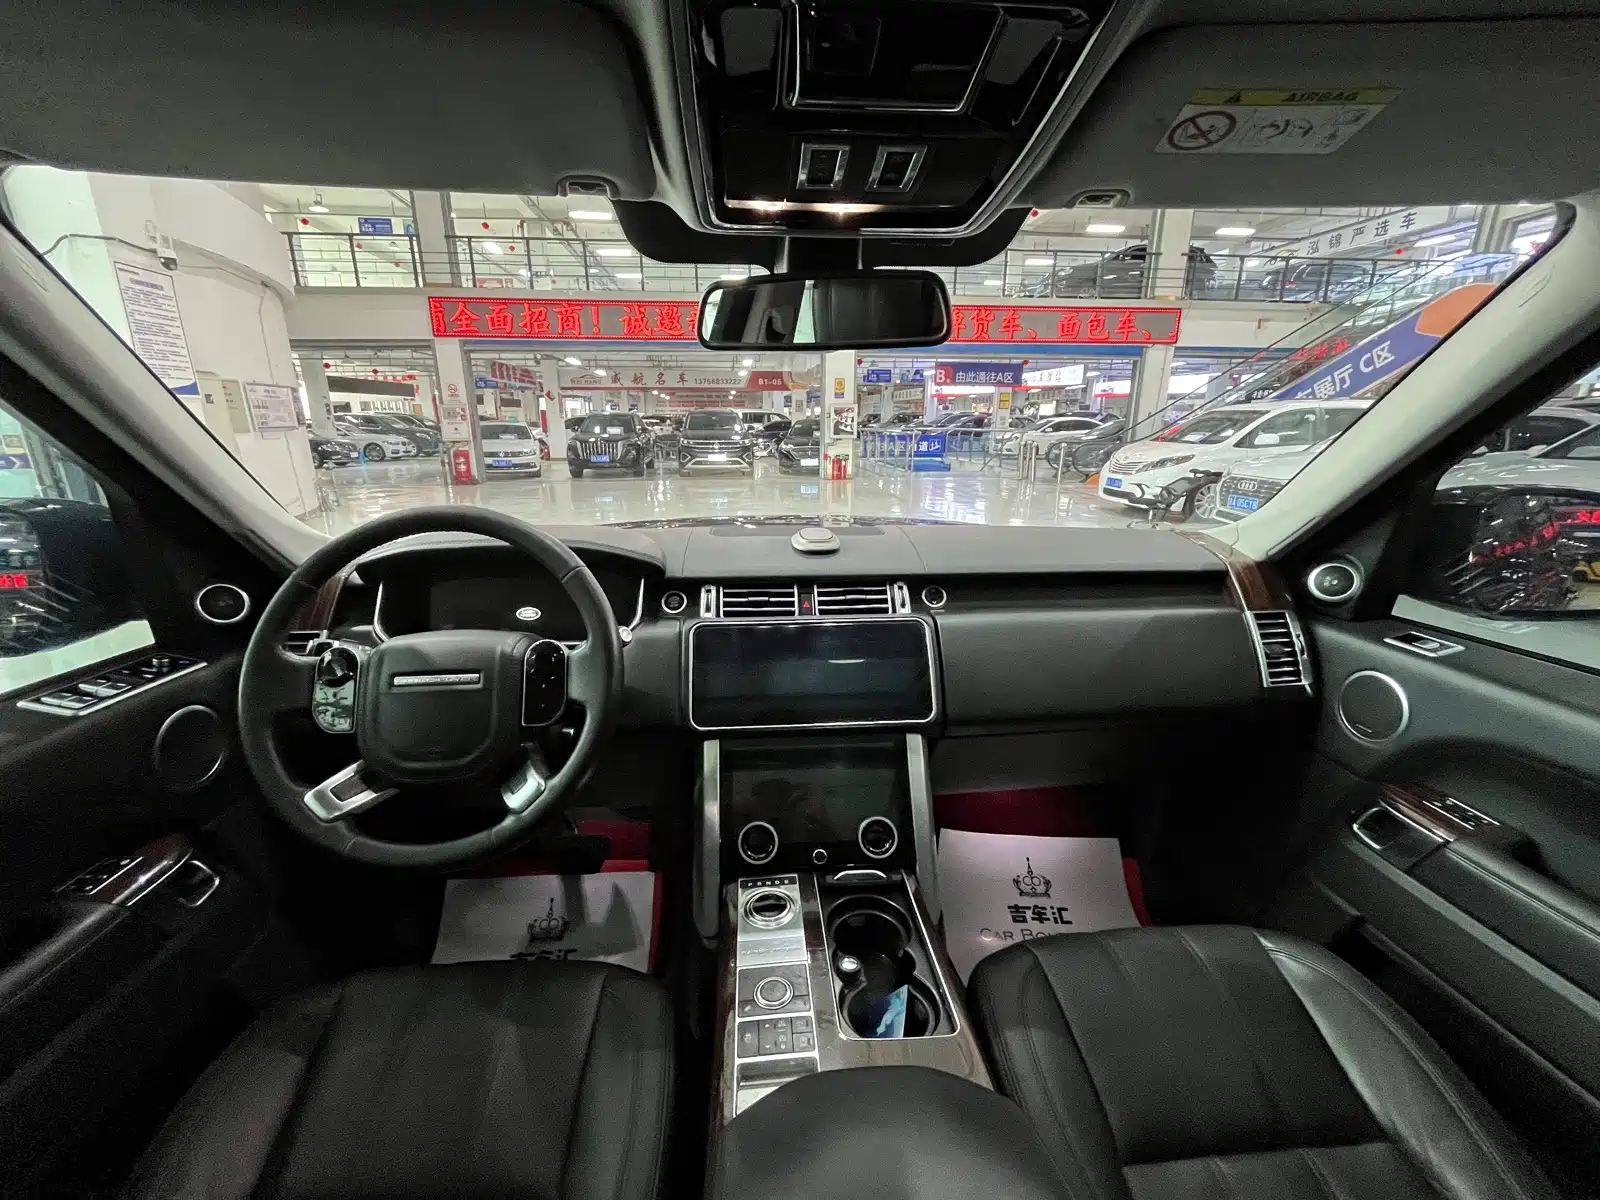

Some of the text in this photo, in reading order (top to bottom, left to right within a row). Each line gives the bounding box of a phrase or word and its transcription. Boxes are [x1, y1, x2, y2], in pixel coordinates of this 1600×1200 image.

[1306, 211, 1417, 256] 泓锦严选车
[951, 308, 1180, 340] 货车、面包车、
[1359, 340, 1395, 373] C区
[955, 371, 1014, 384] 由此通往A区
[1007, 904, 1073, 925] 吉车汇
[979, 927, 1014, 941] CAR
